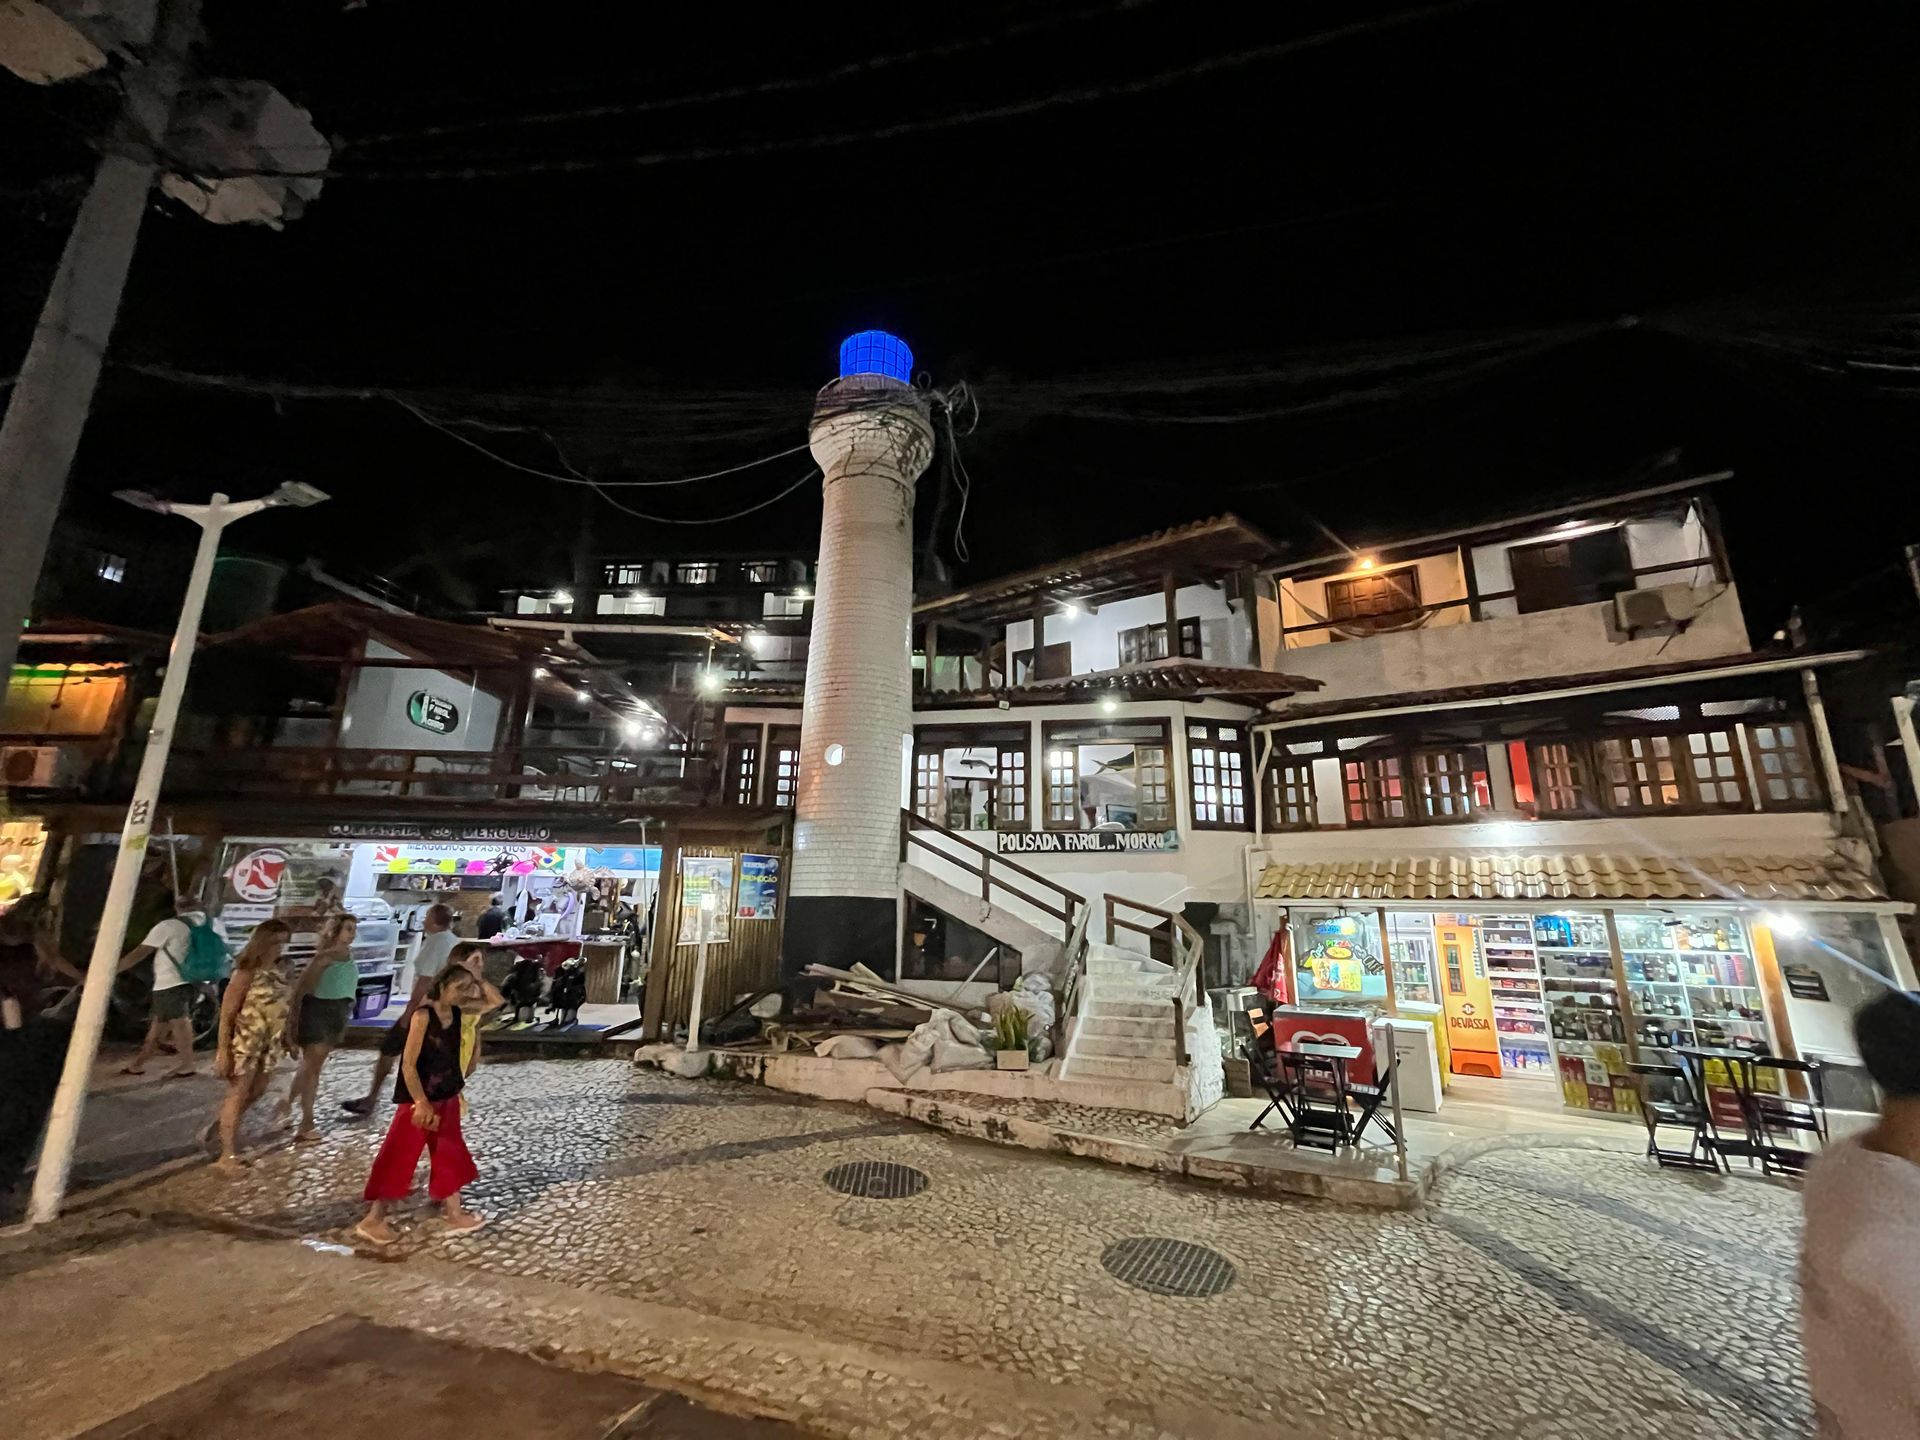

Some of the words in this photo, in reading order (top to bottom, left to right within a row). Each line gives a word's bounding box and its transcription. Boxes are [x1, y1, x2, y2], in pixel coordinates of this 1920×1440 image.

[462, 827, 550, 840] MERGULHO
[998, 833, 1061, 851] POUSADA
[1062, 833, 1106, 851] FAROL
[1115, 832, 1164, 850] MORRO
[1451, 1016, 1491, 1031] DEVASSA
